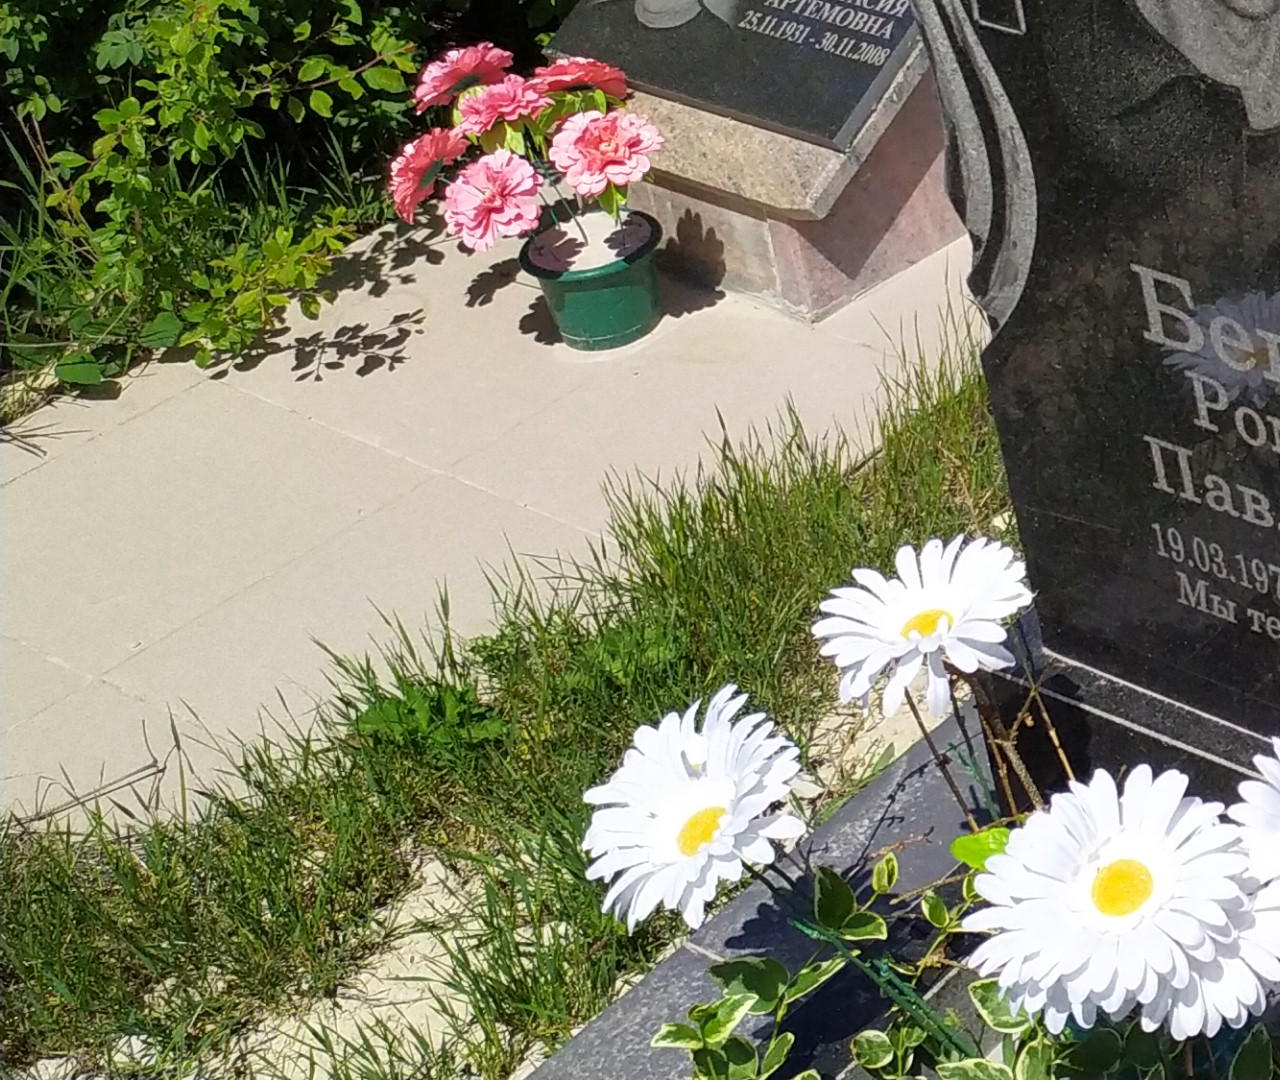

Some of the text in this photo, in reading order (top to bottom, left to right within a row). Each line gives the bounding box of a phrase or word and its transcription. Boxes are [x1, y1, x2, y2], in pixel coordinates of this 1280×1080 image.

[737, 9, 811, 44] 25.11.1931
[814, 31, 891, 67] 30.11.2008
[1176, 572, 1236, 624] Мы
